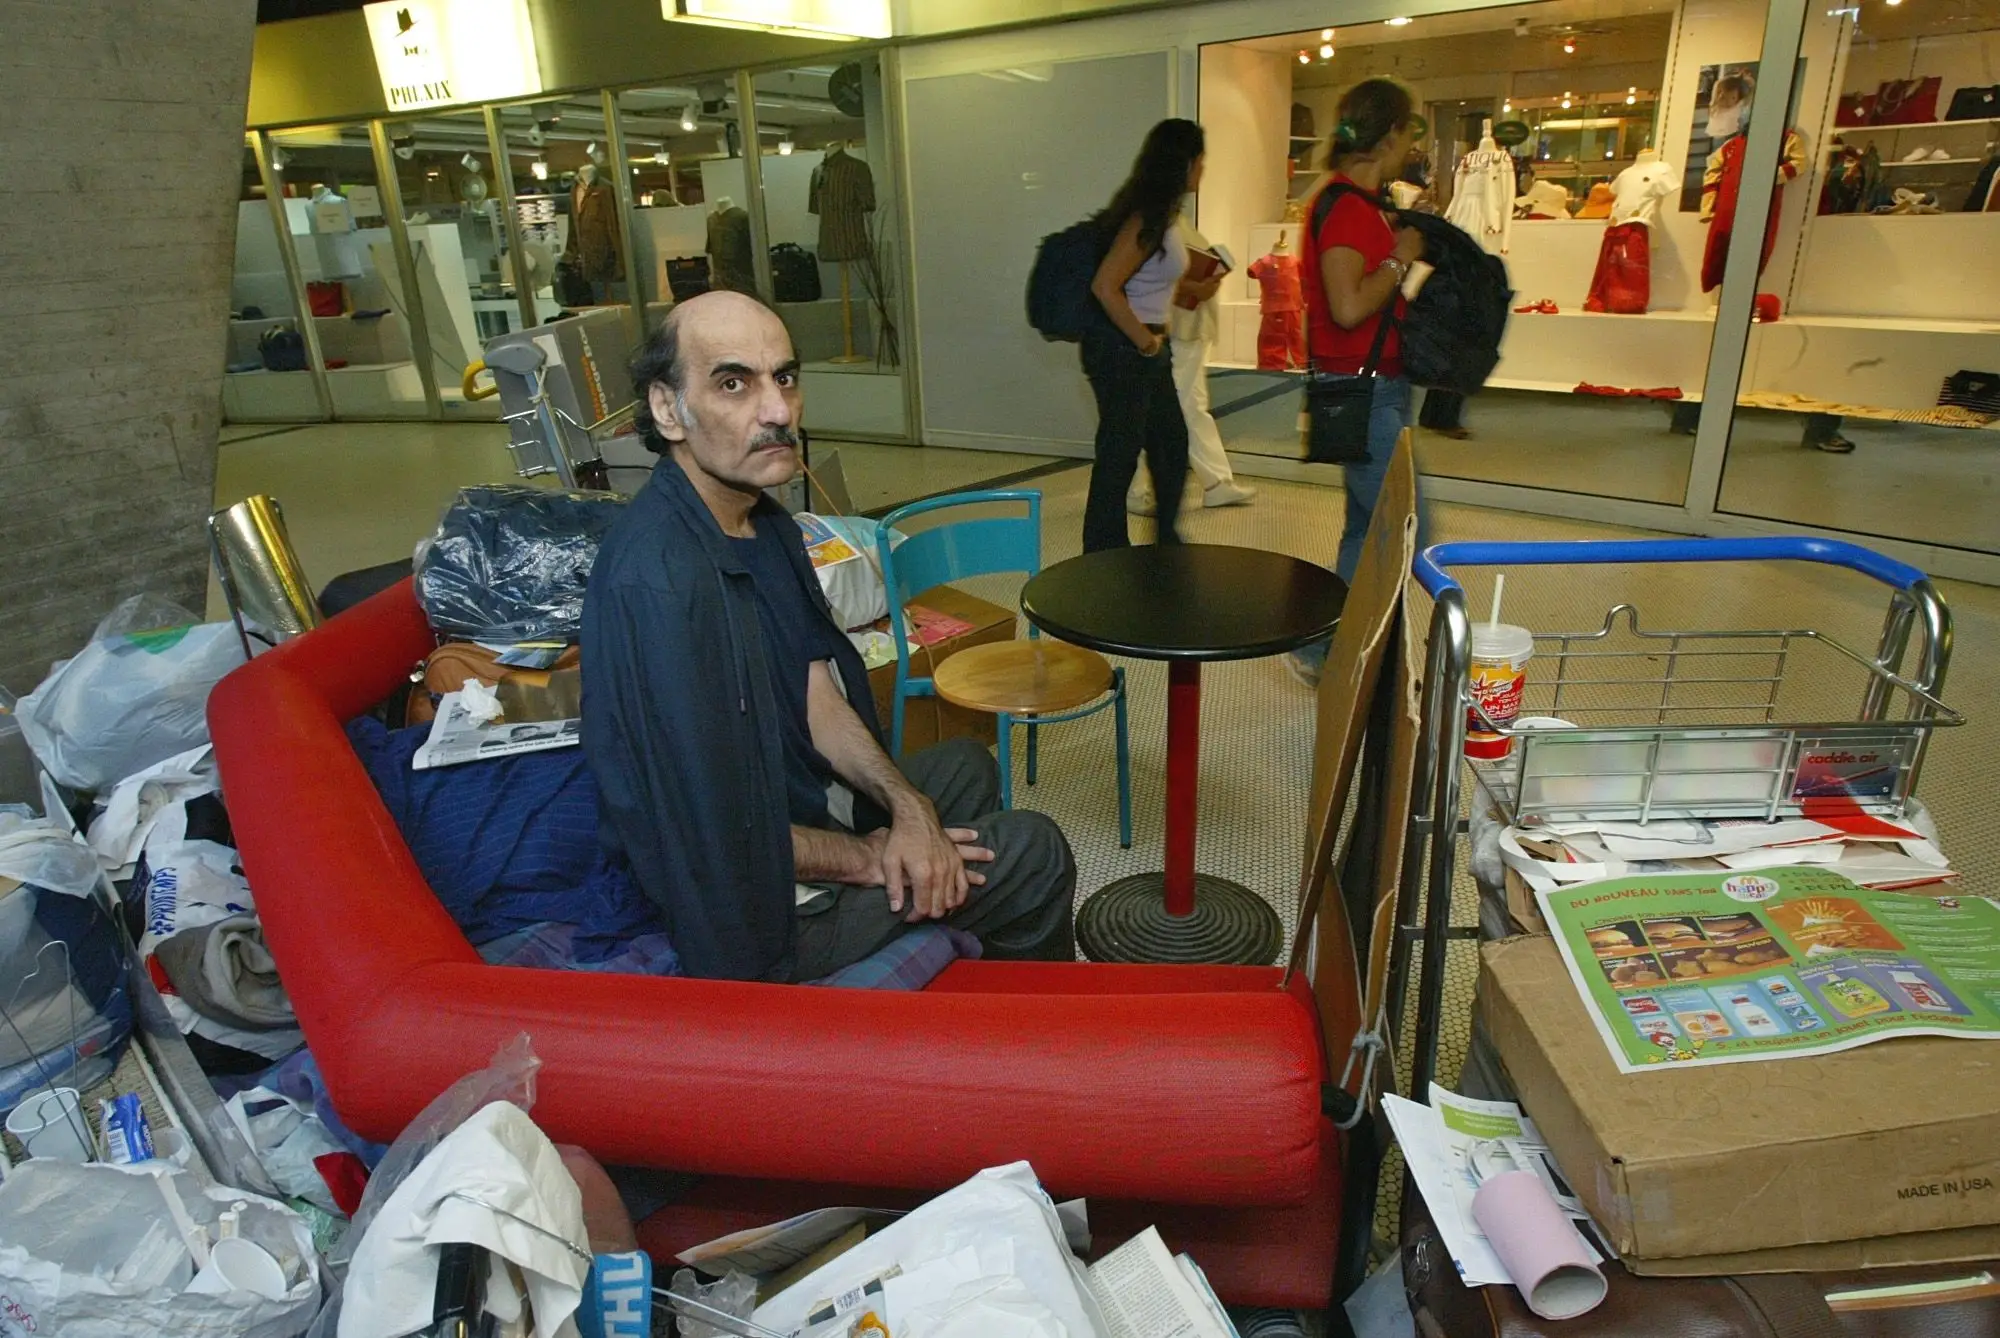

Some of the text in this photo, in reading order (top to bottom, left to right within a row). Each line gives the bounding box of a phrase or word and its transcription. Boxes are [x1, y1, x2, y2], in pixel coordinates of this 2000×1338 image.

[1897, 1177, 1994, 1200] MADE IN USA
